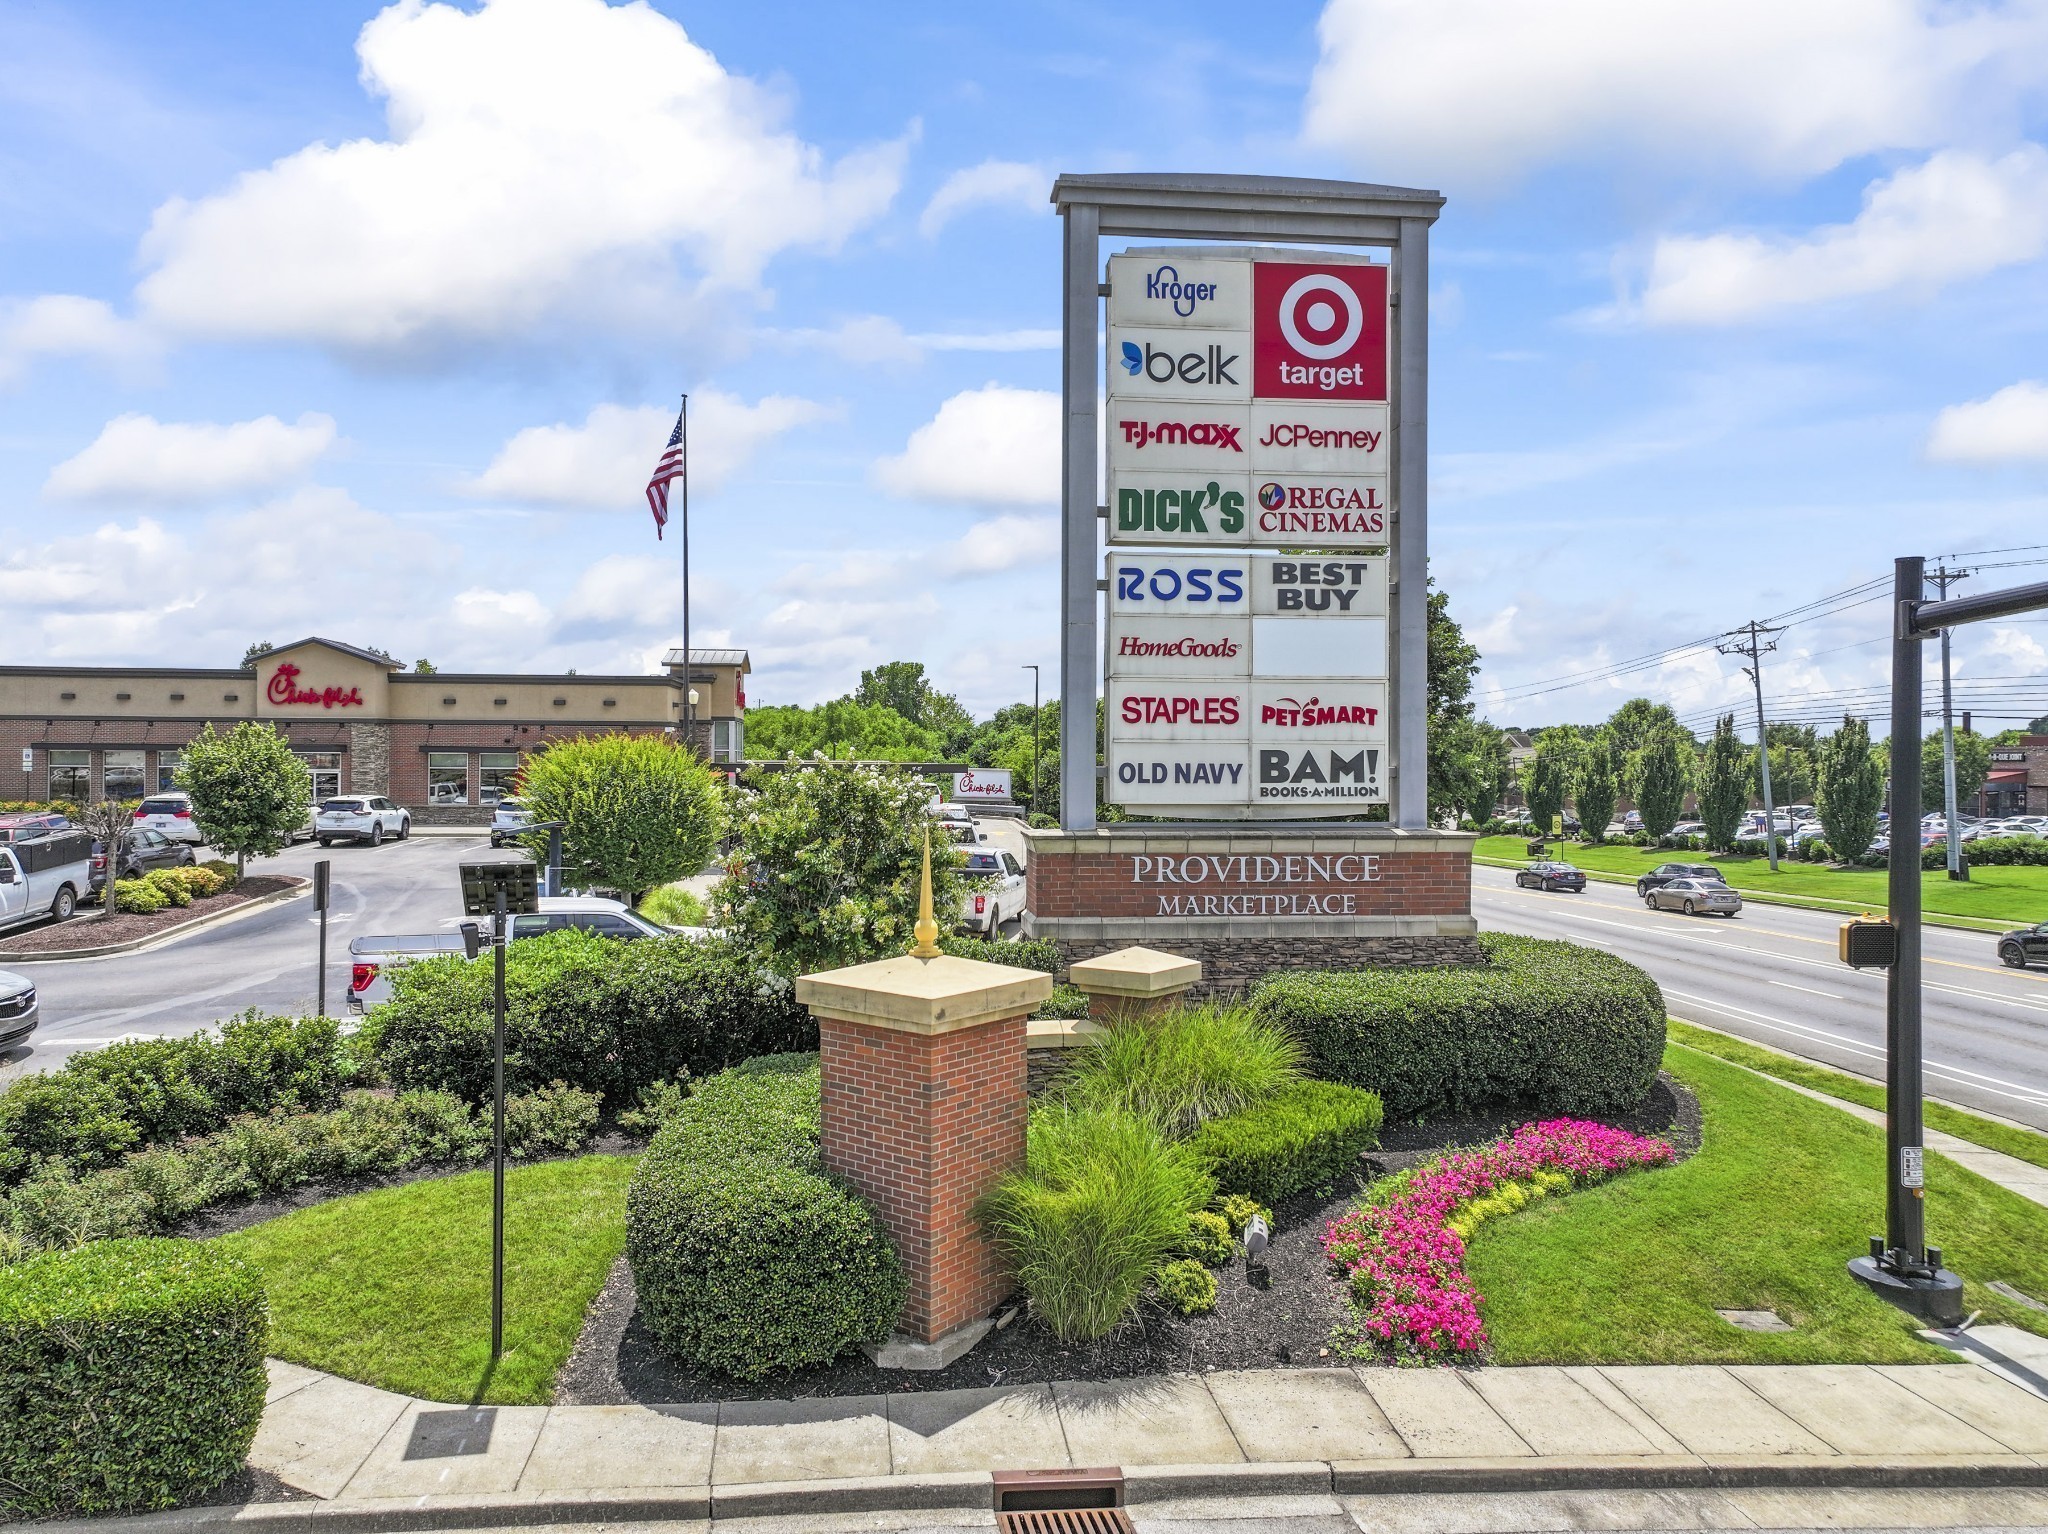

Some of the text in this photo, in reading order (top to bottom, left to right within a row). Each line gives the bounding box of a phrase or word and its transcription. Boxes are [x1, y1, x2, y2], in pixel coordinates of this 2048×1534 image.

[1146, 265, 1217, 317] Kroger
[1145, 342, 1240, 386] belk
[1279, 361, 1364, 391] target
[1259, 423, 1382, 453] JCPenney
[1118, 481, 1245, 534] DICK'S
[1288, 486, 1384, 511] REGAL
[1258, 511, 1384, 534] CINEMAS
[1118, 567, 1244, 603] ROSS
[1272, 562, 1368, 585] BEST
[1277, 588, 1359, 611] BUY
[1117, 636, 1238, 659] HomeGoods
[1121, 696, 1240, 725] STAPLES
[1118, 762, 1244, 785] OLD NAVY
[1259, 749, 1379, 784] BAM!
[1131, 855, 1382, 884] PROVIDENCE
[1156, 893, 1357, 917] MARKETPLACE
